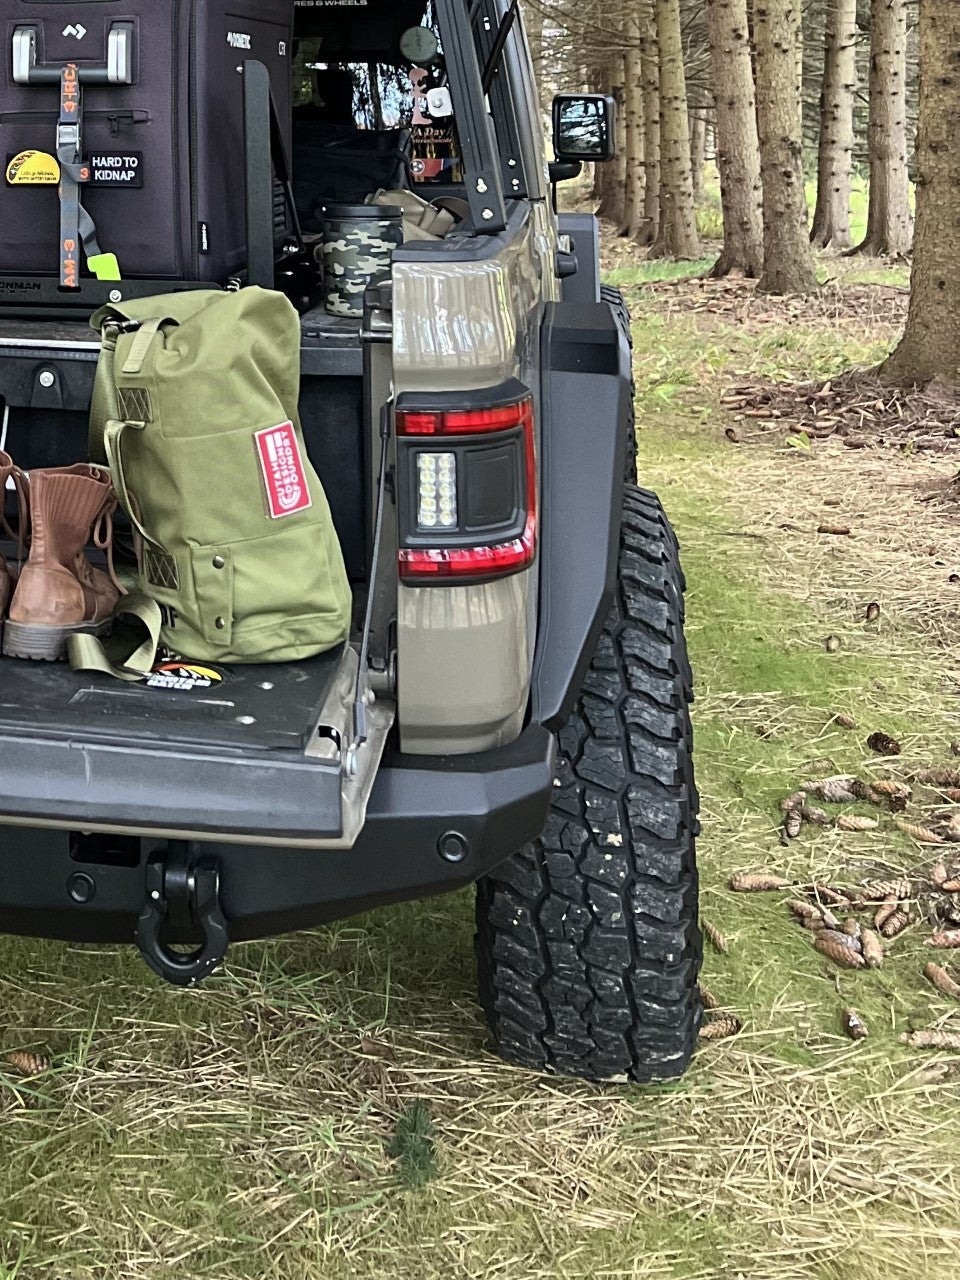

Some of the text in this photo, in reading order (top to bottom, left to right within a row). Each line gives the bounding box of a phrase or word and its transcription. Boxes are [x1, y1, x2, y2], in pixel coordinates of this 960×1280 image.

[325, 0, 368, 7] WHEELS
[92, 156, 139, 168] HARD TO
[94, 170, 136, 181] KIDNAP
[276, 446, 294, 495] DESIGN
[280, 430, 301, 492] FOUNDRY
[271, 460, 285, 497] UTAH
